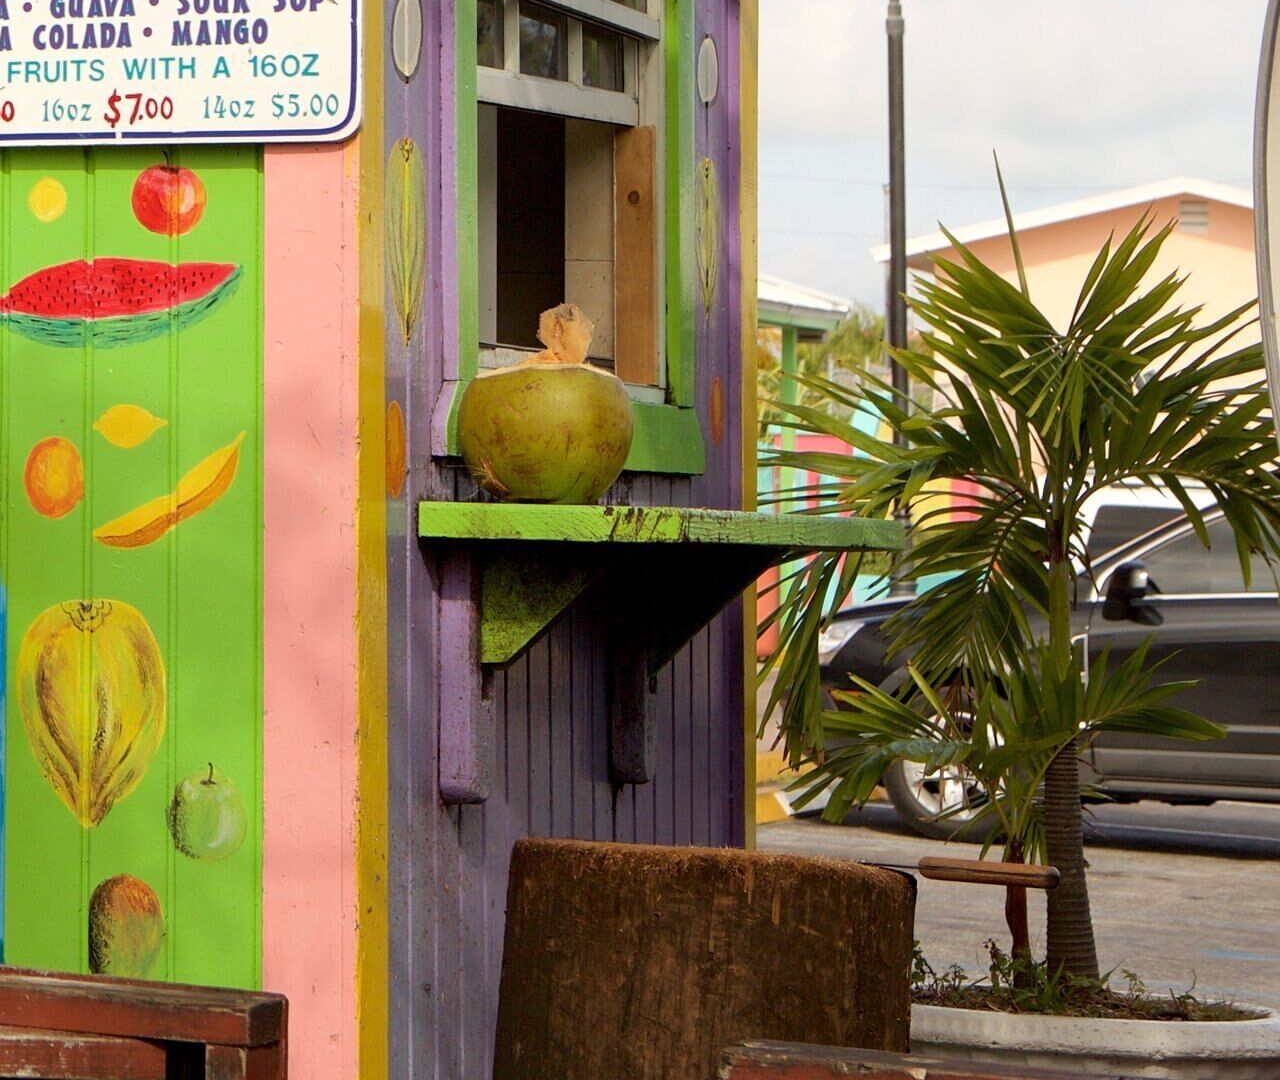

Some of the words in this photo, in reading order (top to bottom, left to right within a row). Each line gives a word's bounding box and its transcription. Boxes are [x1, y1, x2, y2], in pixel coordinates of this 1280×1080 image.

[33, 22, 132, 51] COLADA
[171, 18, 269, 46] MANGO
[8, 59, 105, 83] FRUITS
[122, 56, 197, 80] WITH
[213, 58, 231, 79] A
[248, 53, 320, 79] 16OZ
[104, 89, 174, 128] $7.00
[272, 92, 340, 118] $5.00
